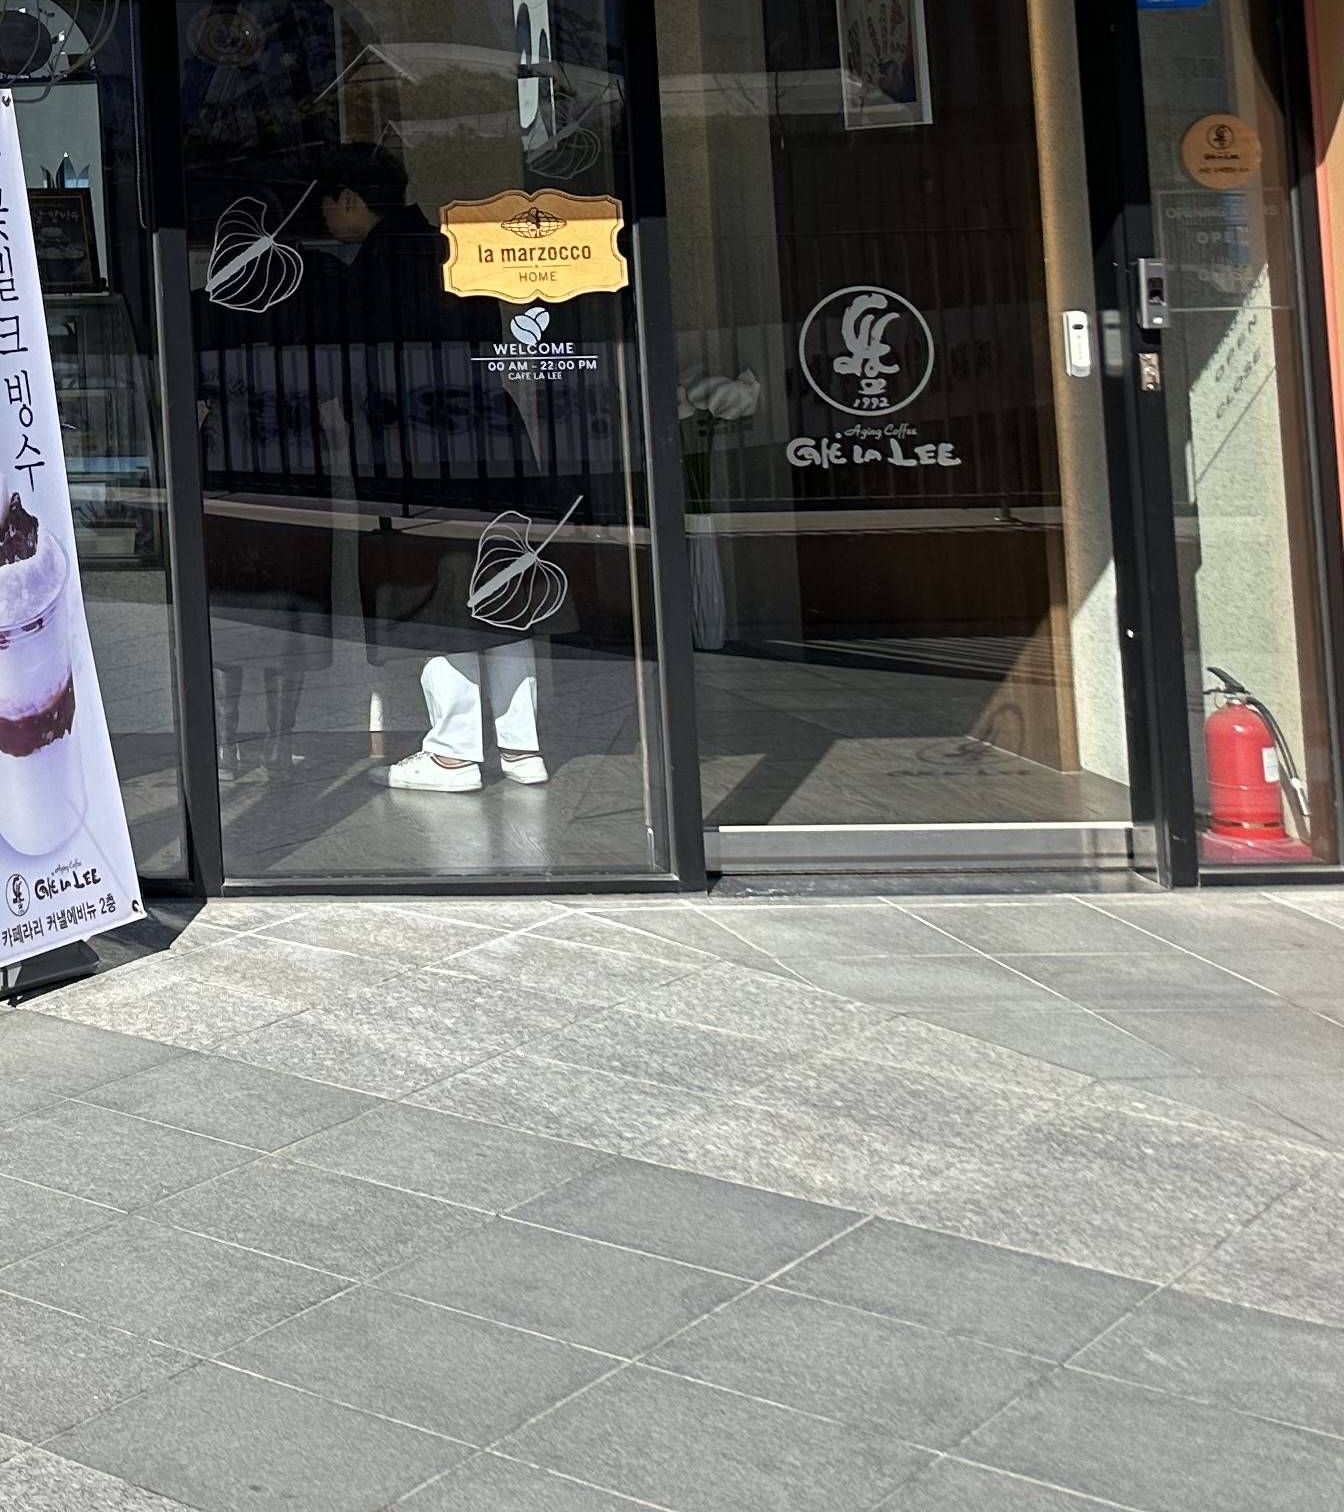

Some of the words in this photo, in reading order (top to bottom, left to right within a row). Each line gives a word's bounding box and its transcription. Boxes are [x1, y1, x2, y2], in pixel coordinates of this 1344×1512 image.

[478, 244, 495, 264] la
[500, 243, 592, 263] marzocco
[518, 271, 558, 283] HOME
[493, 343, 575, 356] WELCOME
[508, 361, 529, 372] AM
[578, 360, 598, 371] PM
[852, 397, 890, 408] 1992
[844, 423, 883, 440] Aging
[883, 423, 918, 437] Coffee
[888, 438, 962, 467] LEE
[72, 868, 102, 889] LEE
[1, 917, 45, 948] 카페라리
[98, 892, 117, 915] 2층
